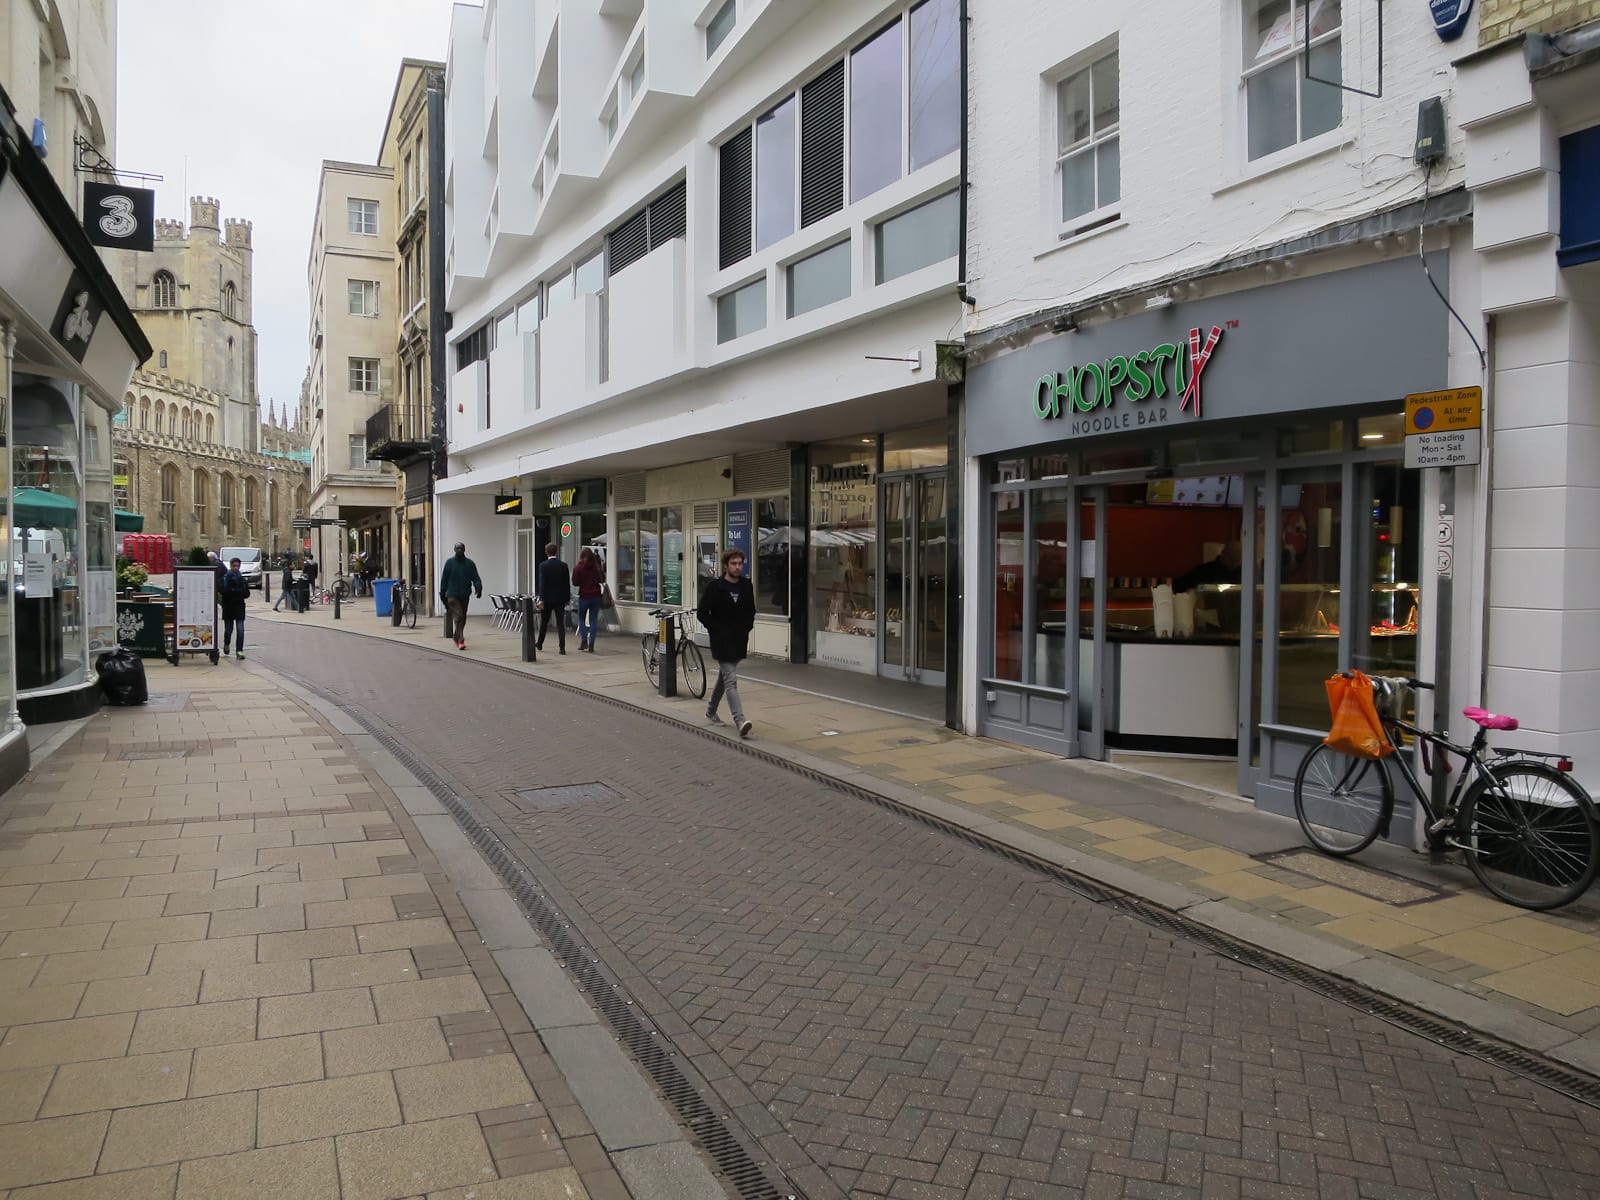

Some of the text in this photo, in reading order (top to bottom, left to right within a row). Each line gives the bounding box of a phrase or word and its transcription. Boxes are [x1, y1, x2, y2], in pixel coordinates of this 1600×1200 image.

[98, 195, 138, 238] 3
[1033, 325, 1222, 417] CHOPSTIX
[1410, 391, 1477, 405] Pedestrian Zone
[1443, 406, 1472, 415] At any
[1071, 406, 1169, 436] NOODLE BAR
[1448, 416, 1468, 424] time
[1418, 434, 1465, 444] No loading
[1421, 446, 1439, 454] Mon
[1447, 443, 1461, 452] Sat
[1417, 456, 1439, 464] 10am
[1446, 454, 1466, 463] 4pm
[549, 488, 576, 509] SUBWAY
